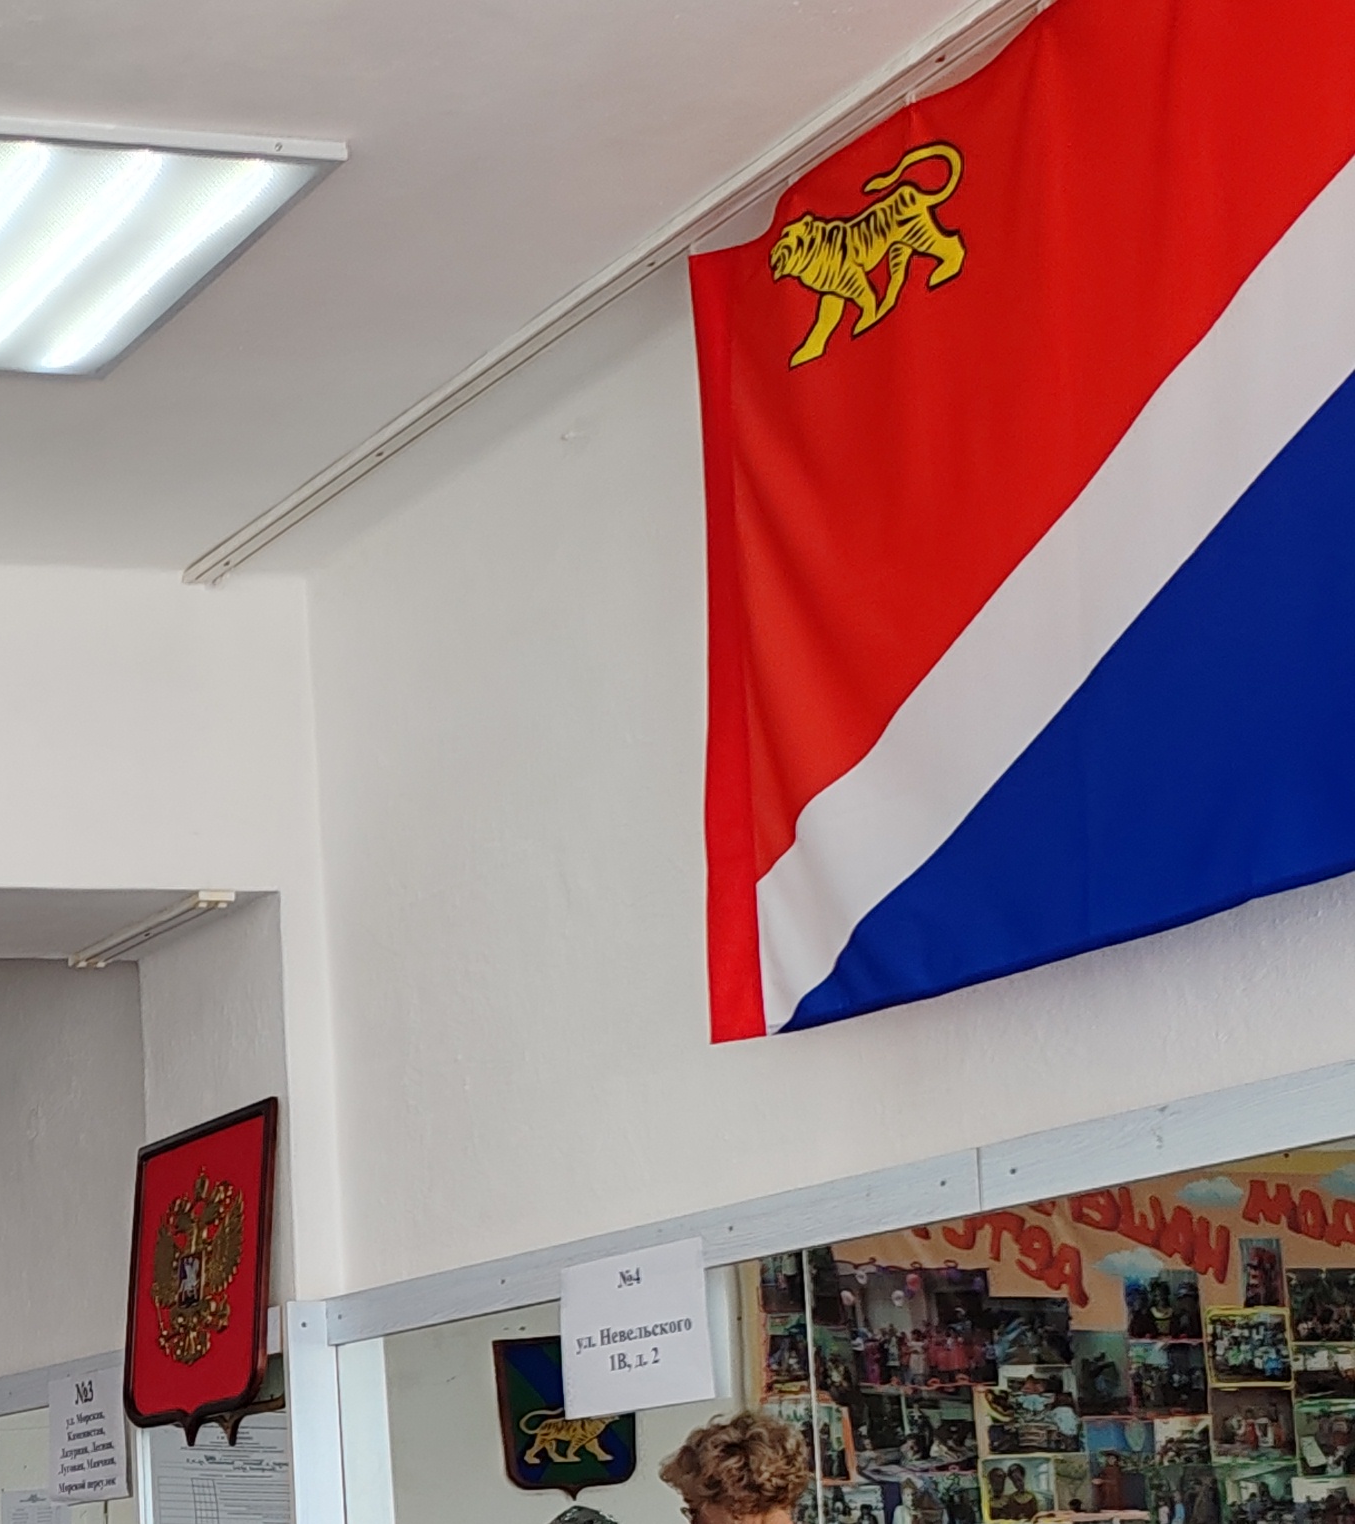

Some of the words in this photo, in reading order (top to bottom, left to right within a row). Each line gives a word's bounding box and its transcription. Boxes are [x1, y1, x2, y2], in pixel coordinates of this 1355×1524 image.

[617, 1267, 641, 1288] №4
[576, 1336, 597, 1355] ул.
[599, 1318, 692, 1347] Невельского
[651, 1347, 661, 1364] 2
[75, 1379, 94, 1405] №3
